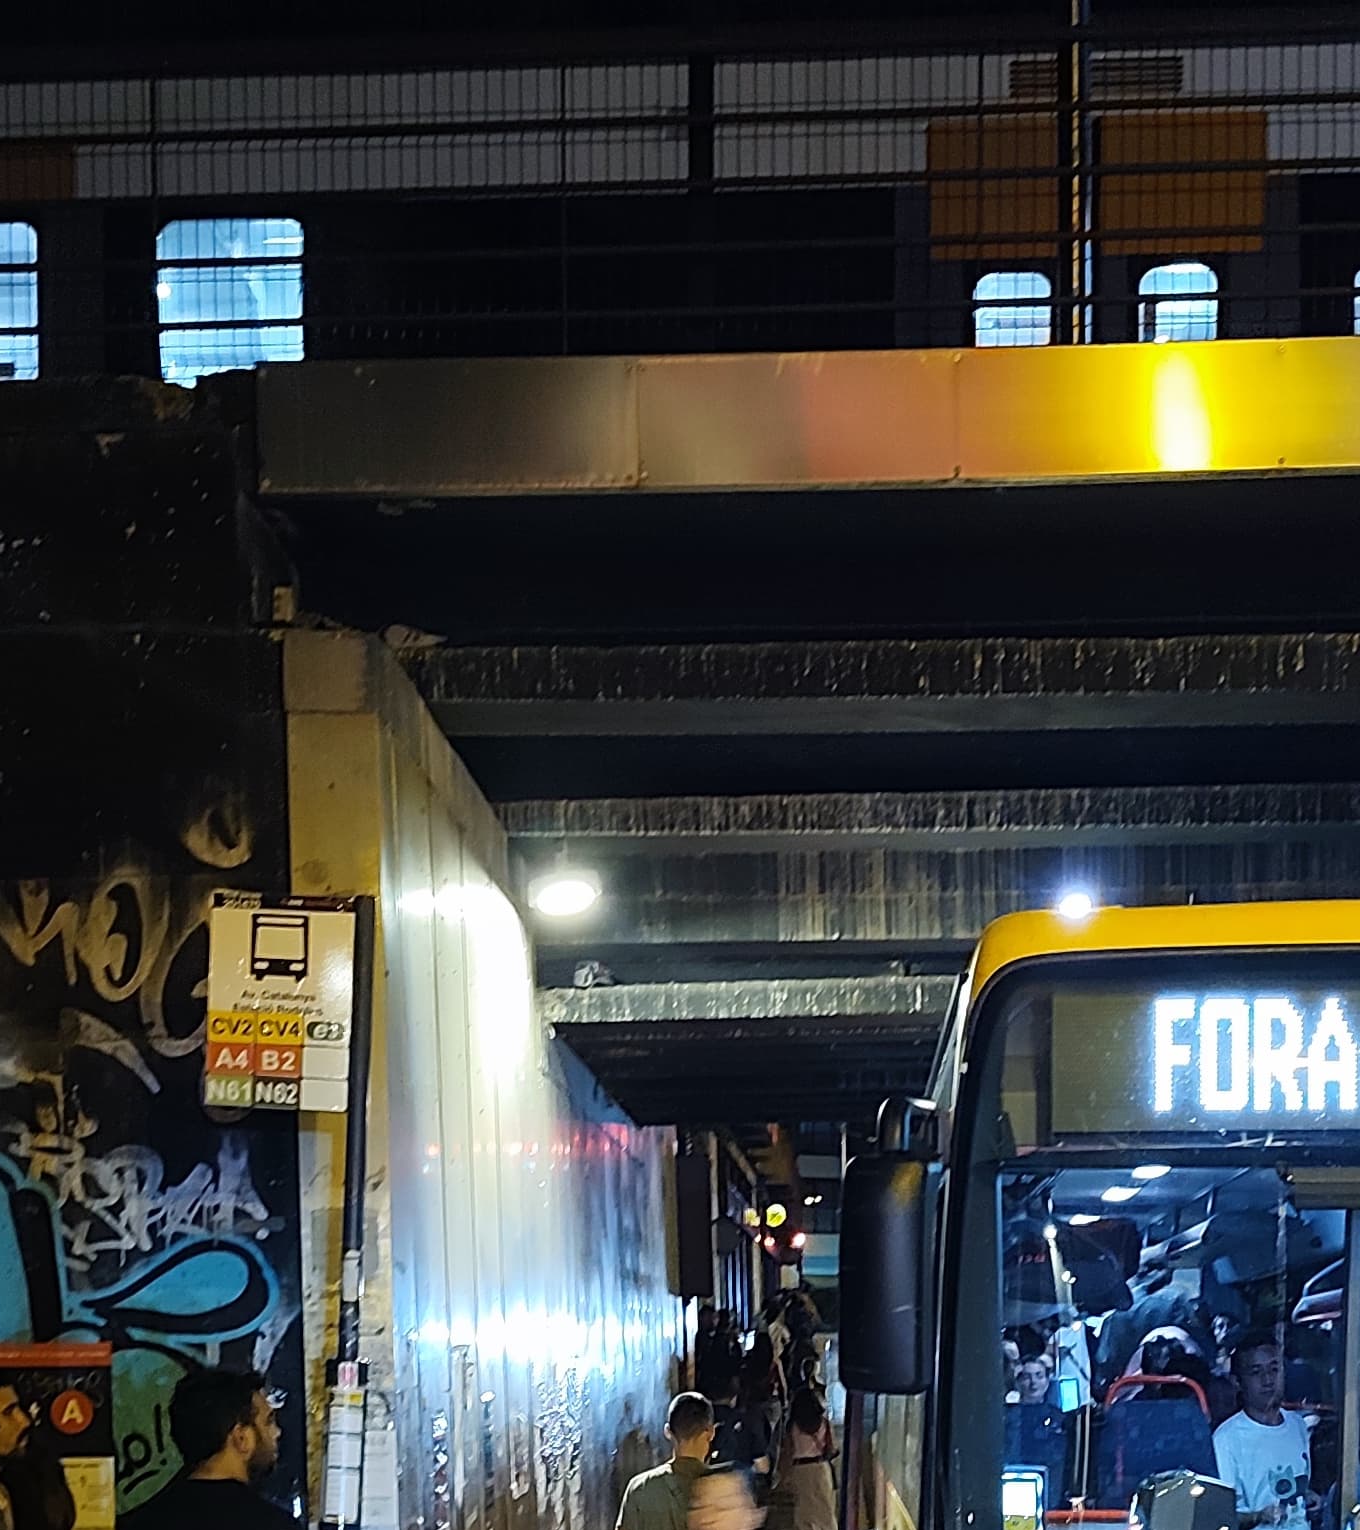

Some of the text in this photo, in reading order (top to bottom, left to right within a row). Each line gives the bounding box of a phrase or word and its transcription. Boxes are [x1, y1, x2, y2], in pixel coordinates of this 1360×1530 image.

[261, 991, 316, 1003] Catalunya
[212, 1018, 253, 1035] CV2
[259, 1020, 300, 1037] CV4
[215, 1047, 296, 1071] A4 B2
[1153, 993, 1358, 1111] FORA
[207, 1079, 298, 1105] N61 N62
[60, 1399, 84, 1424] A
